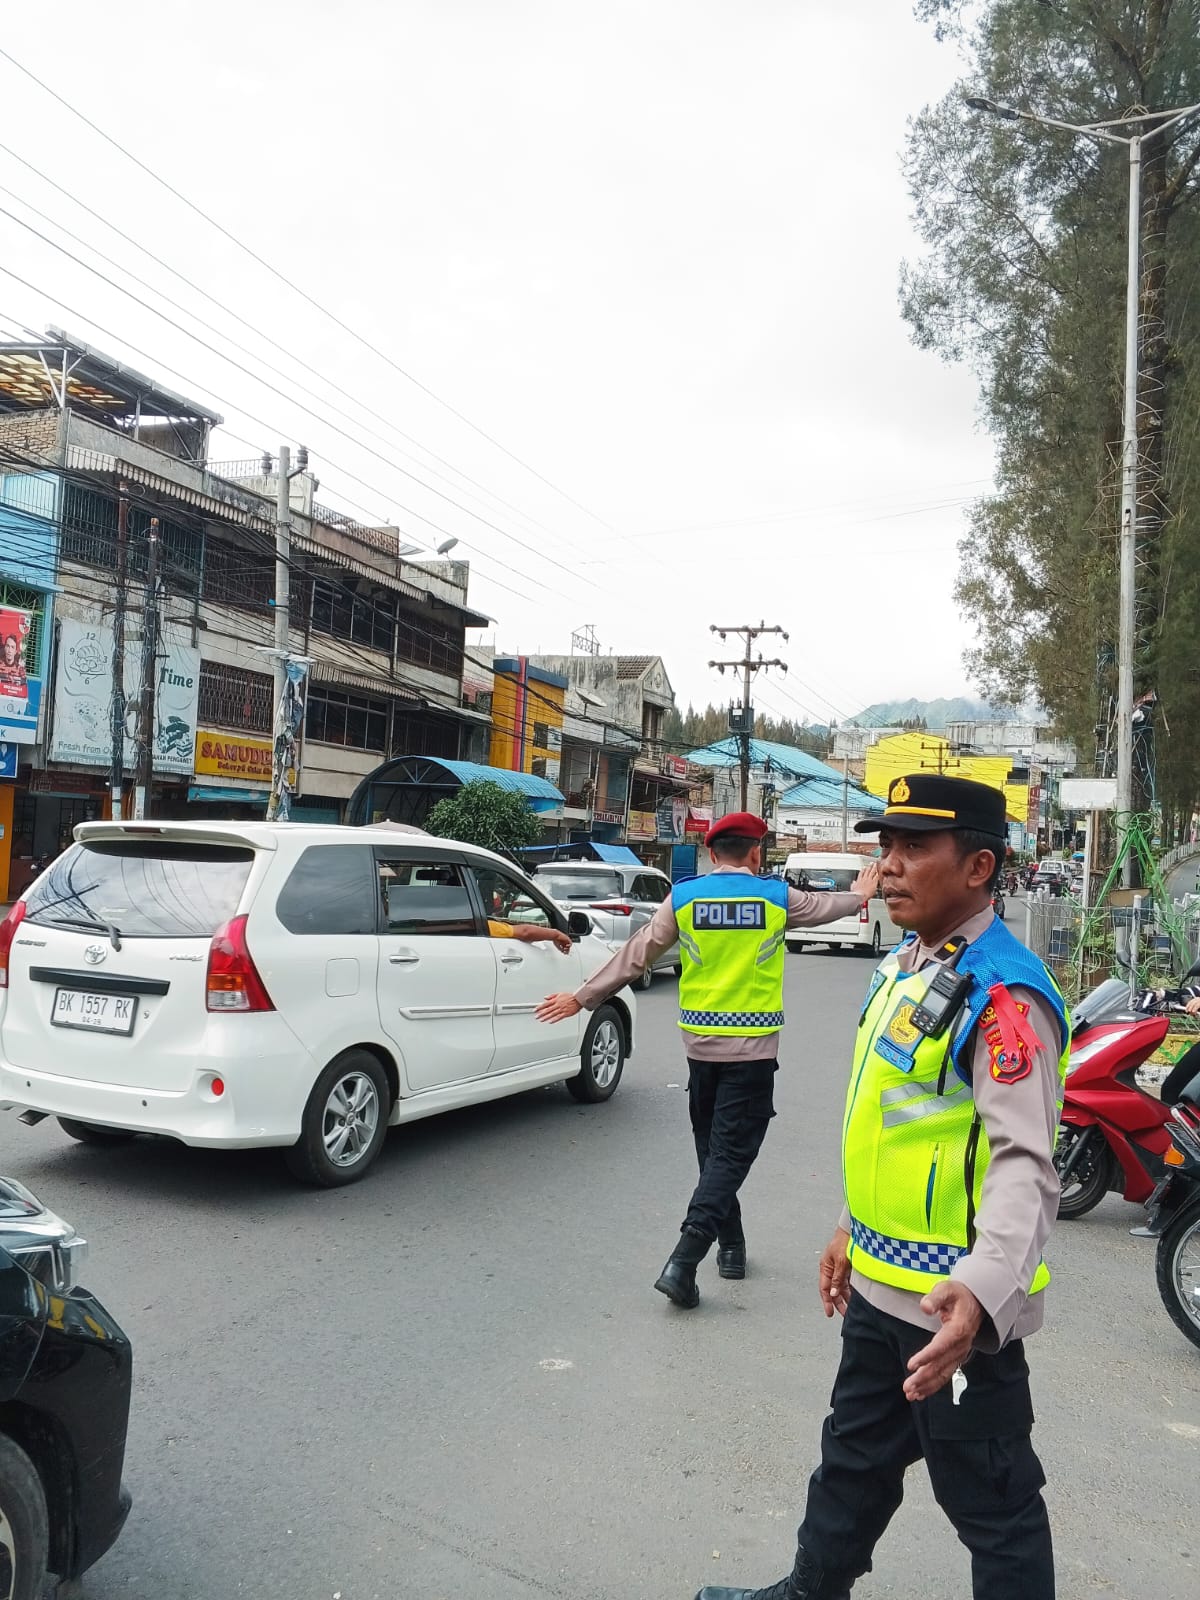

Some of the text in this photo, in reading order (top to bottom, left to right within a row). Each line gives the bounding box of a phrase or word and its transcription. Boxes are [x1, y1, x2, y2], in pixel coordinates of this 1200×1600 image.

[86, 632, 96, 641] 12
[69, 647, 76, 656] 9
[102, 655, 108, 664] 3
[84, 676, 90, 685] 6
[160, 667, 194, 689] Time
[58, 741, 81, 751] Fresh
[83, 744, 101, 754] from
[201, 740, 272, 766] SAMUDE
[695, 903, 761, 926] POLISI
[59, 992, 131, 1019] BK 1557 RK
